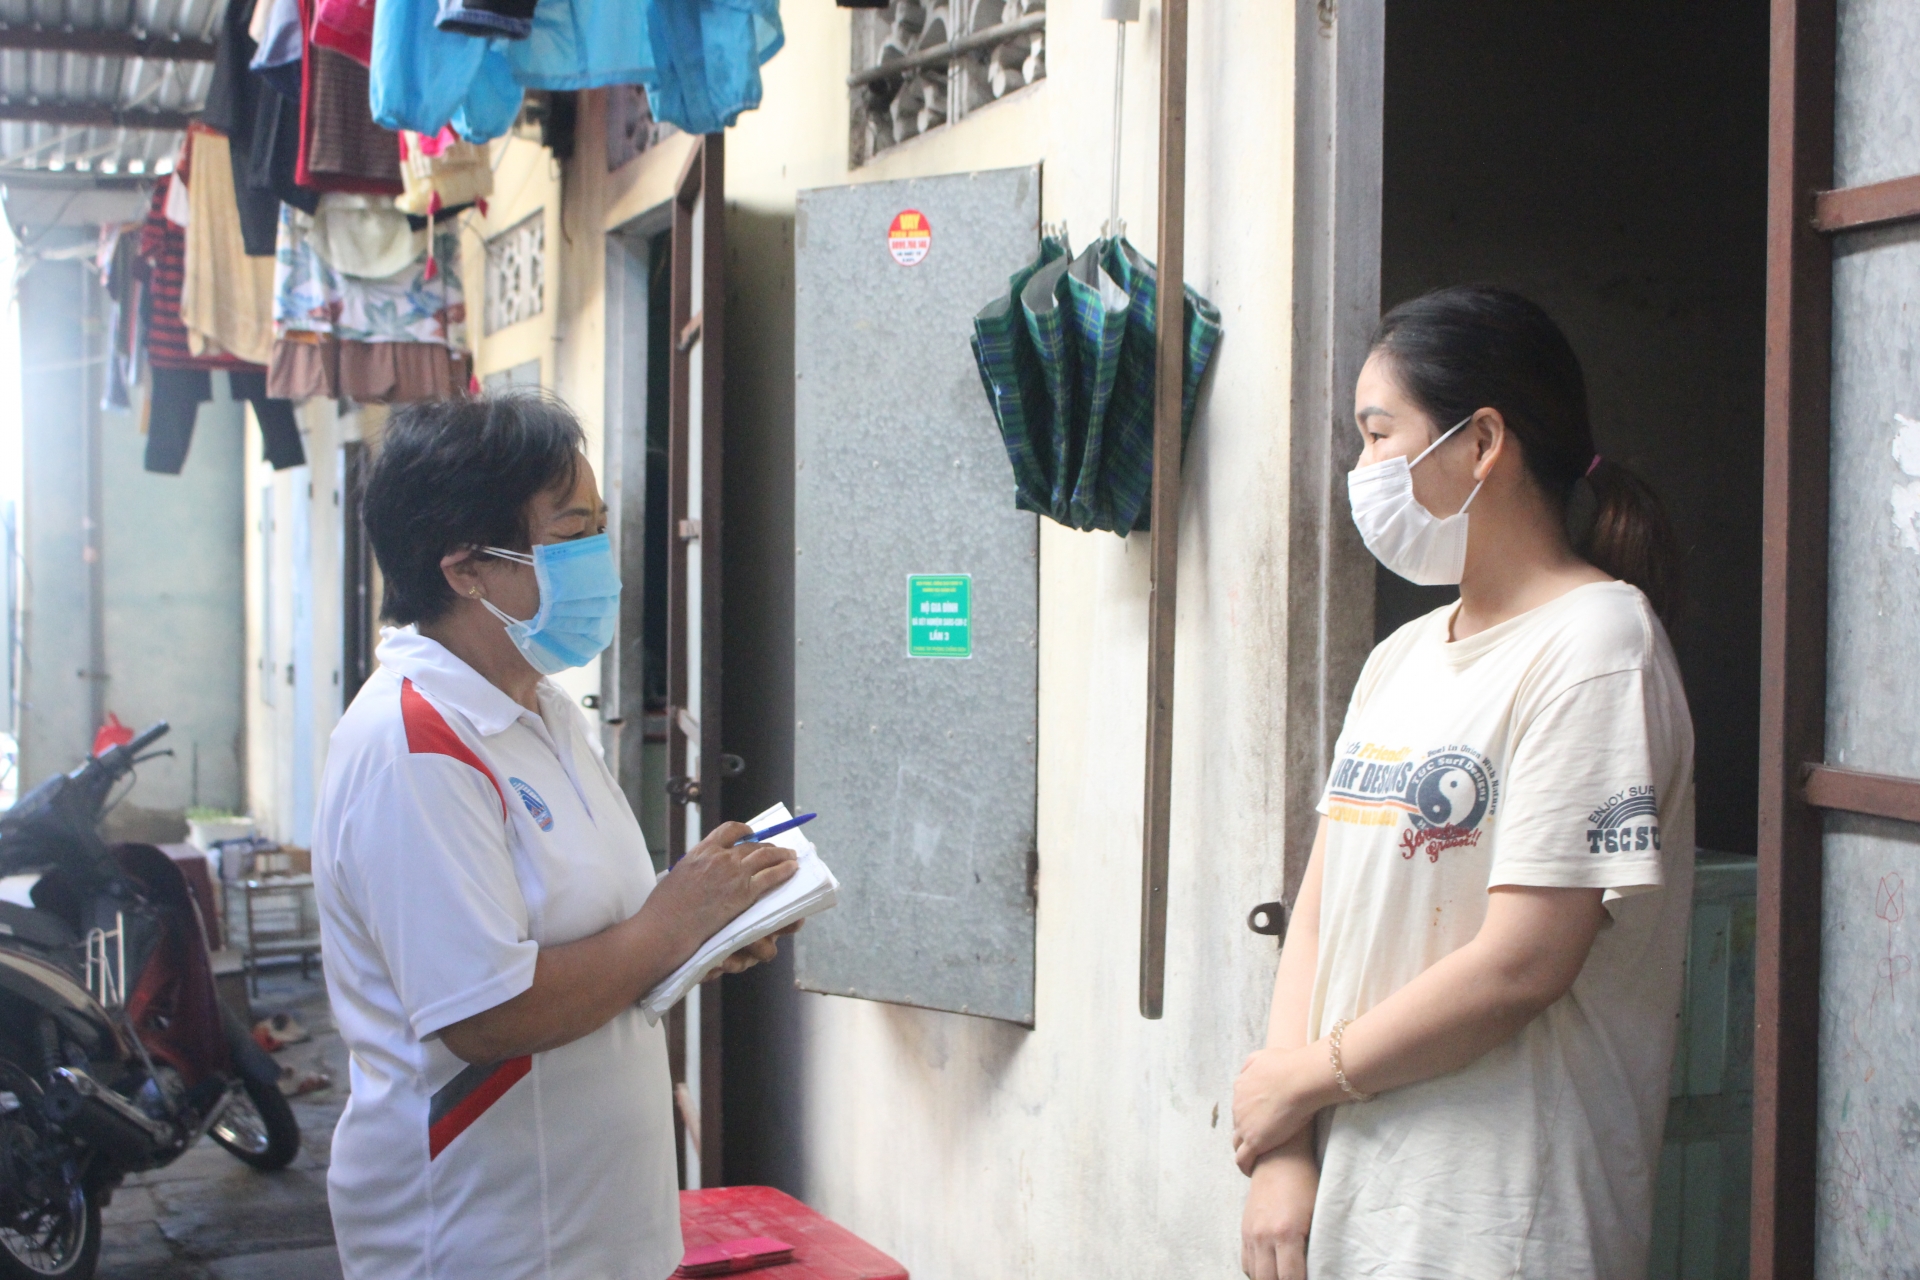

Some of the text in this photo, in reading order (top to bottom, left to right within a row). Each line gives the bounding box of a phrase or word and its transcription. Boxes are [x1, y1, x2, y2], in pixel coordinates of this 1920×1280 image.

[1437, 757, 1466, 767] Surf
[1588, 790, 1625, 824] ENJOY
[1587, 827, 1631, 854] T&C
